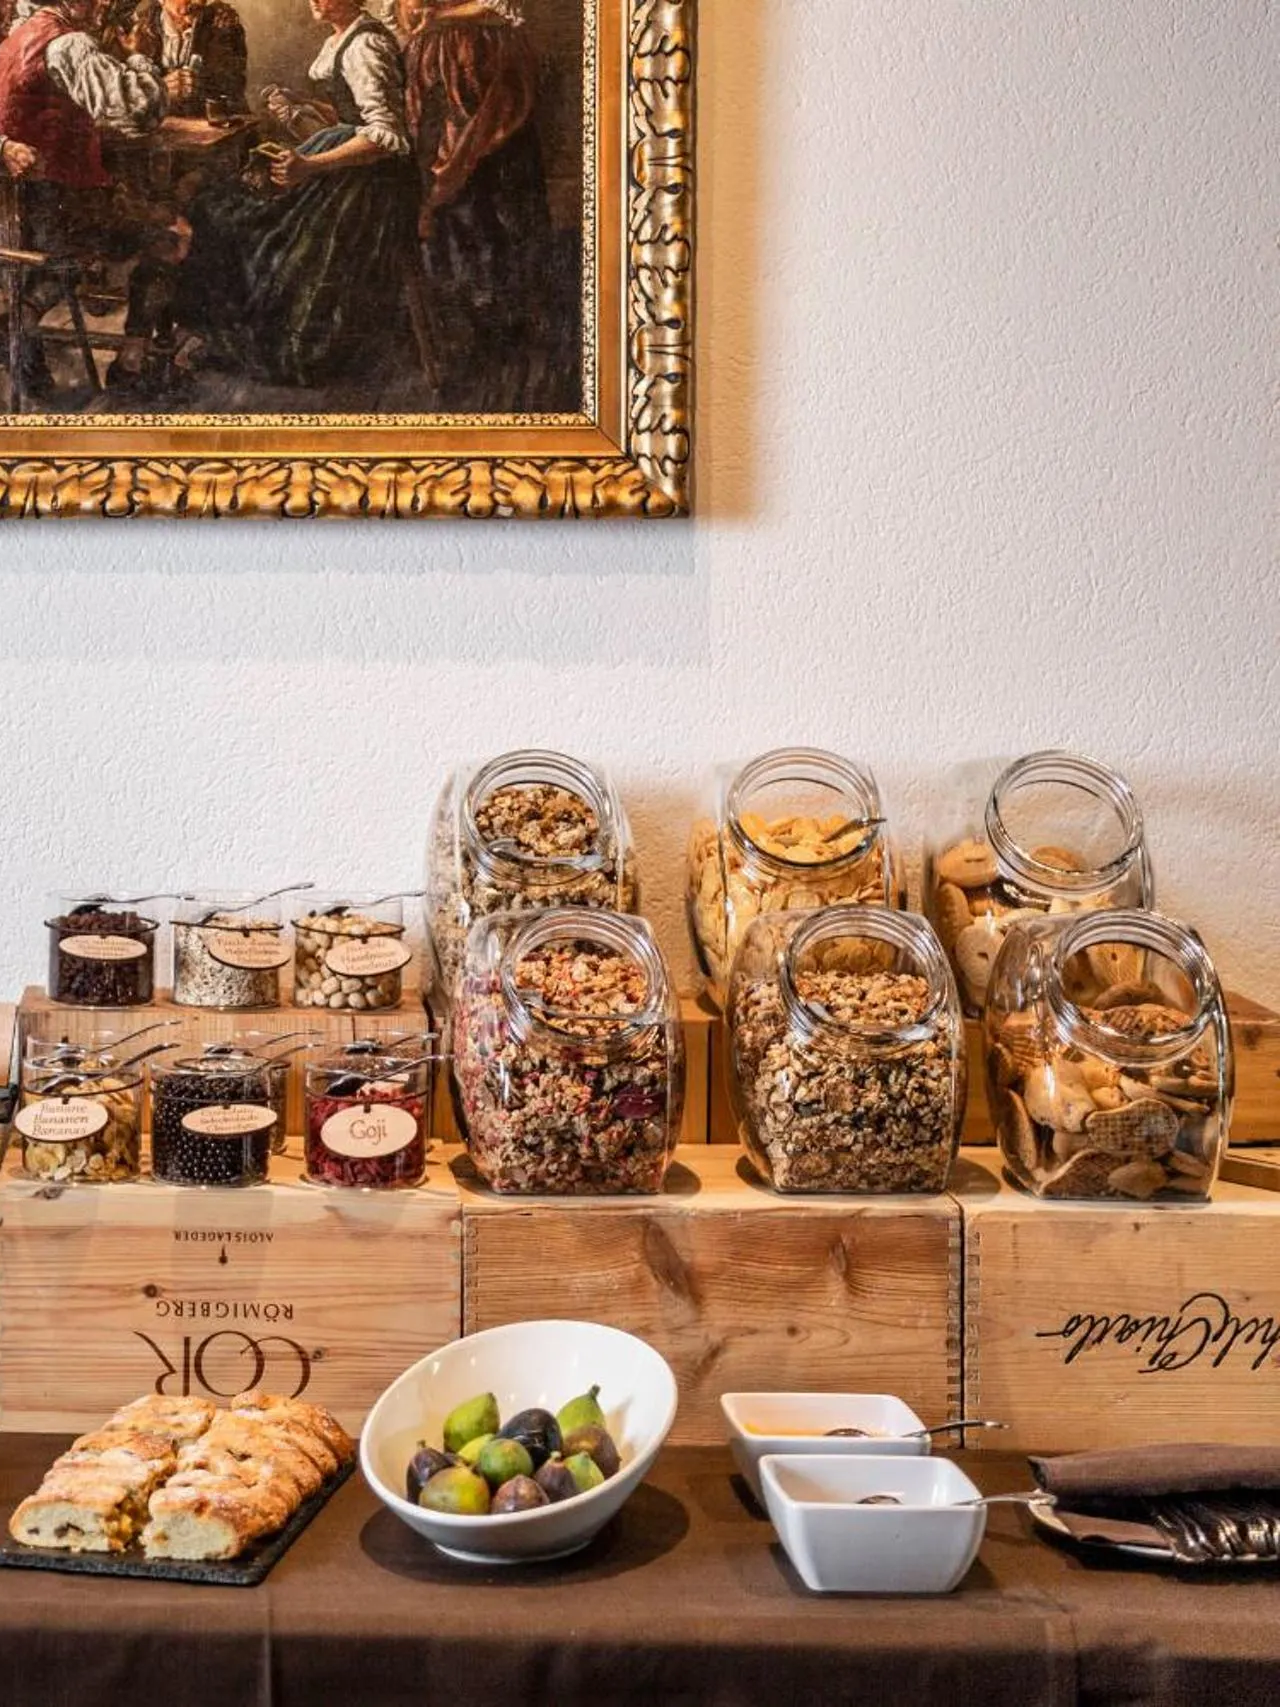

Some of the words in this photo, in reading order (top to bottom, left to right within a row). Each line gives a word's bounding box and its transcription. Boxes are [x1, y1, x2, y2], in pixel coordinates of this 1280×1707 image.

[349, 1118, 388, 1143] Goji
[171, 1229, 232, 1243] LAGEDER
[234, 1231, 275, 1244] ALOIS
[154, 1299, 294, 1323] RÖMIGBERG
[132, 1329, 312, 1400] COR
